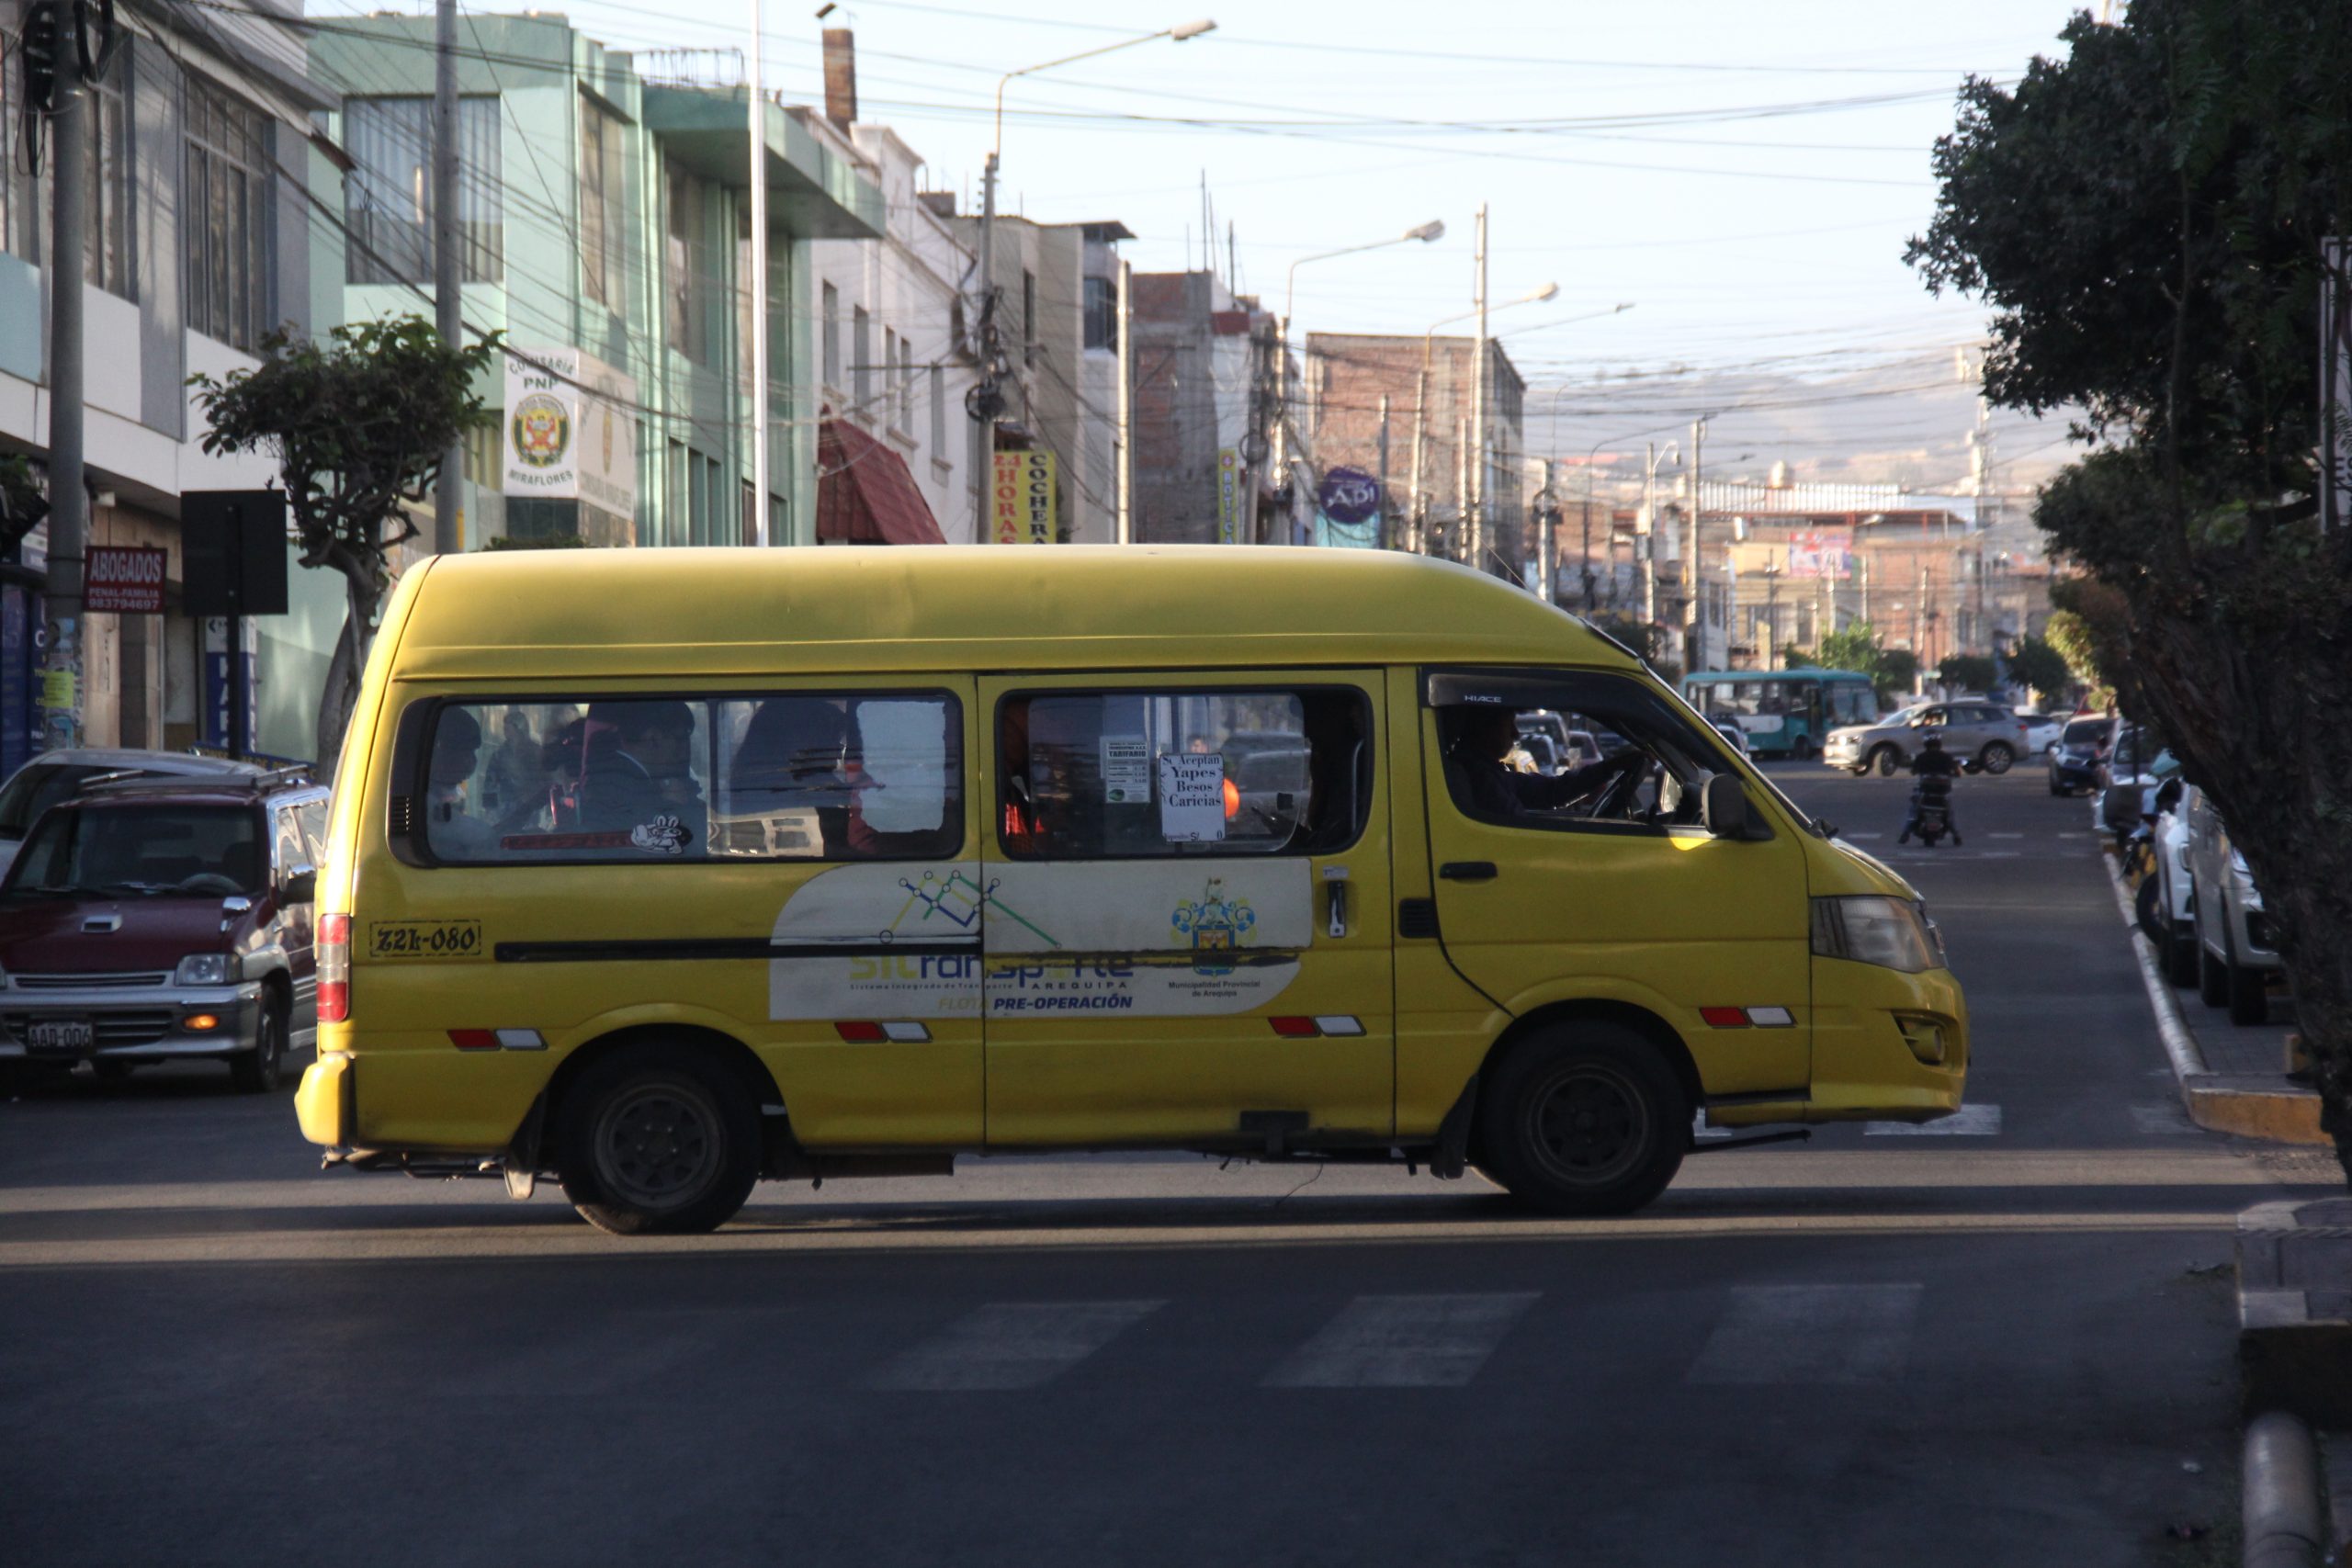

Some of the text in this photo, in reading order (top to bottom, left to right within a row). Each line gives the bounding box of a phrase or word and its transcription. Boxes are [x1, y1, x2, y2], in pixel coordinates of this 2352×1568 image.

[524, 377, 560, 389] PNP
[509, 468, 573, 486] MIRAFLORES
[997, 468, 1018, 544] HORAS
[89, 551, 162, 583] ABOGADOS
[88, 587, 160, 598] PENAL-FAMILIA
[1178, 754, 1220, 768] Aceptan
[1171, 766, 1216, 781] Yapes
[1176, 781, 1213, 792] Besos
[1170, 794, 1221, 807] Caricias
[1032, 982, 1127, 990] AREQUIPA
[1169, 980, 1220, 988] Municipalidad
[994, 993, 1133, 1010] PRE-OPERACIÓN
